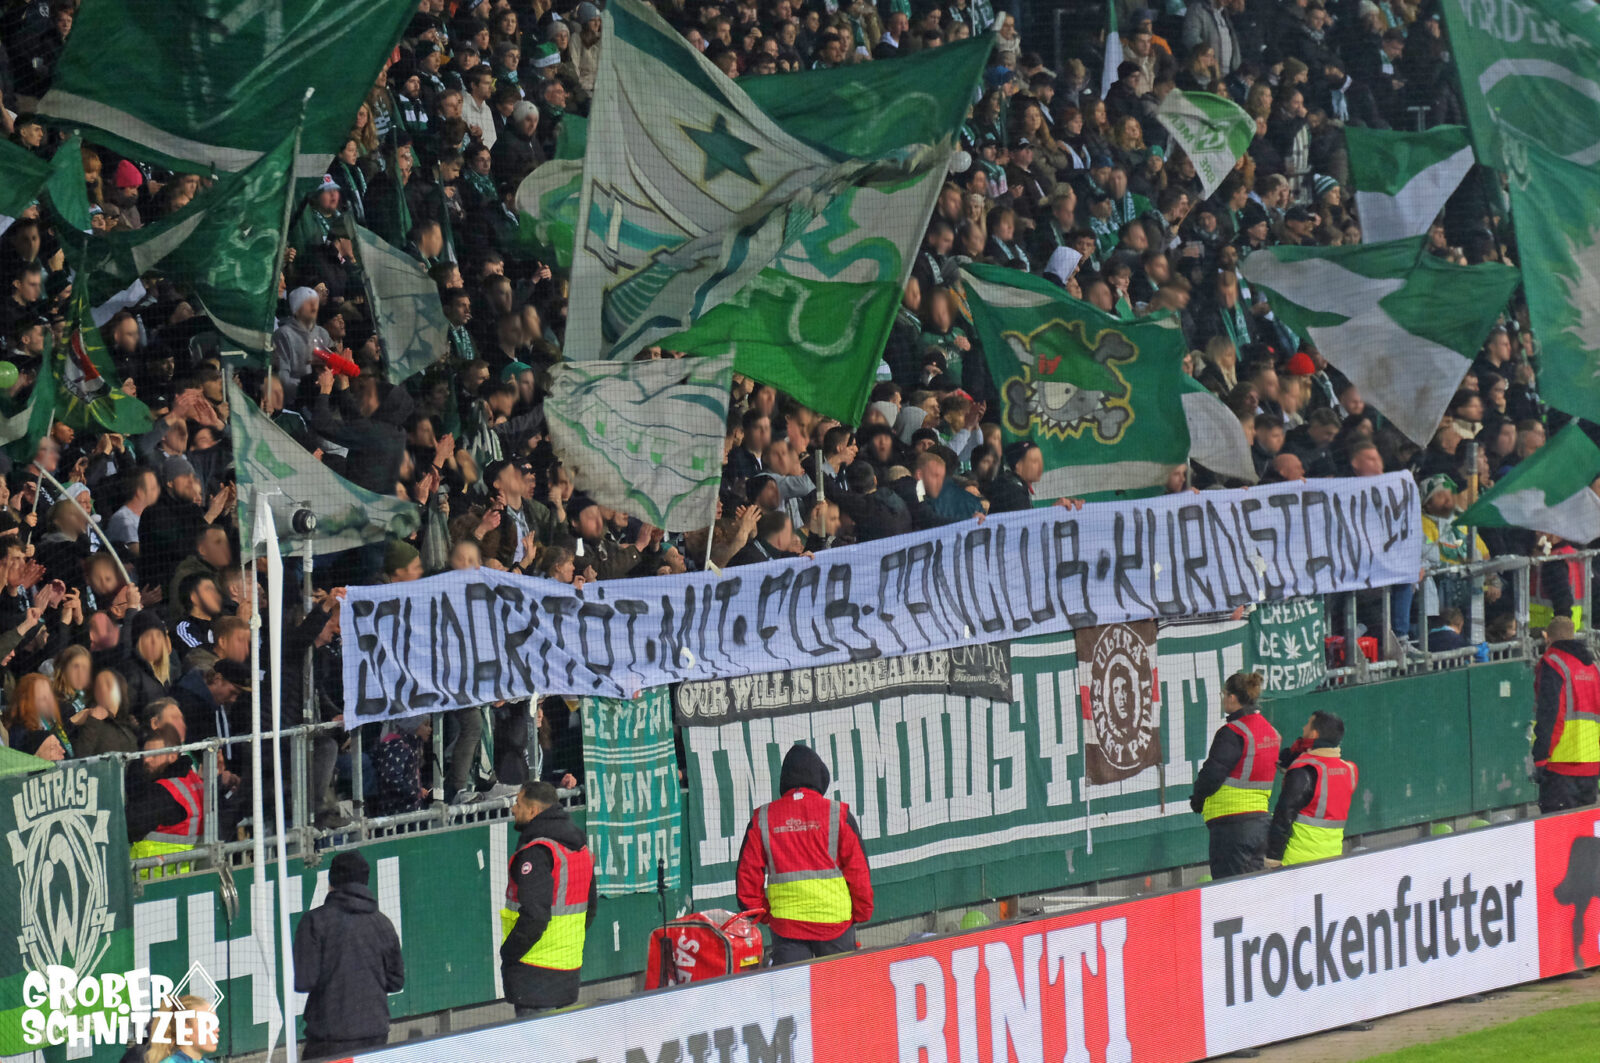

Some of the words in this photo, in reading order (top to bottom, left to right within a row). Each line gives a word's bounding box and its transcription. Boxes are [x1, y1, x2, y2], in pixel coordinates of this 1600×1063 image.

[659, 576, 746, 678] MIT
[1259, 631, 1282, 658] DE
[678, 680, 730, 718] OUR
[730, 671, 790, 711] WILL
[791, 667, 813, 704] IS
[22, 767, 90, 820] ULTRAS
[1213, 873, 1523, 1007] Trockenfutter
